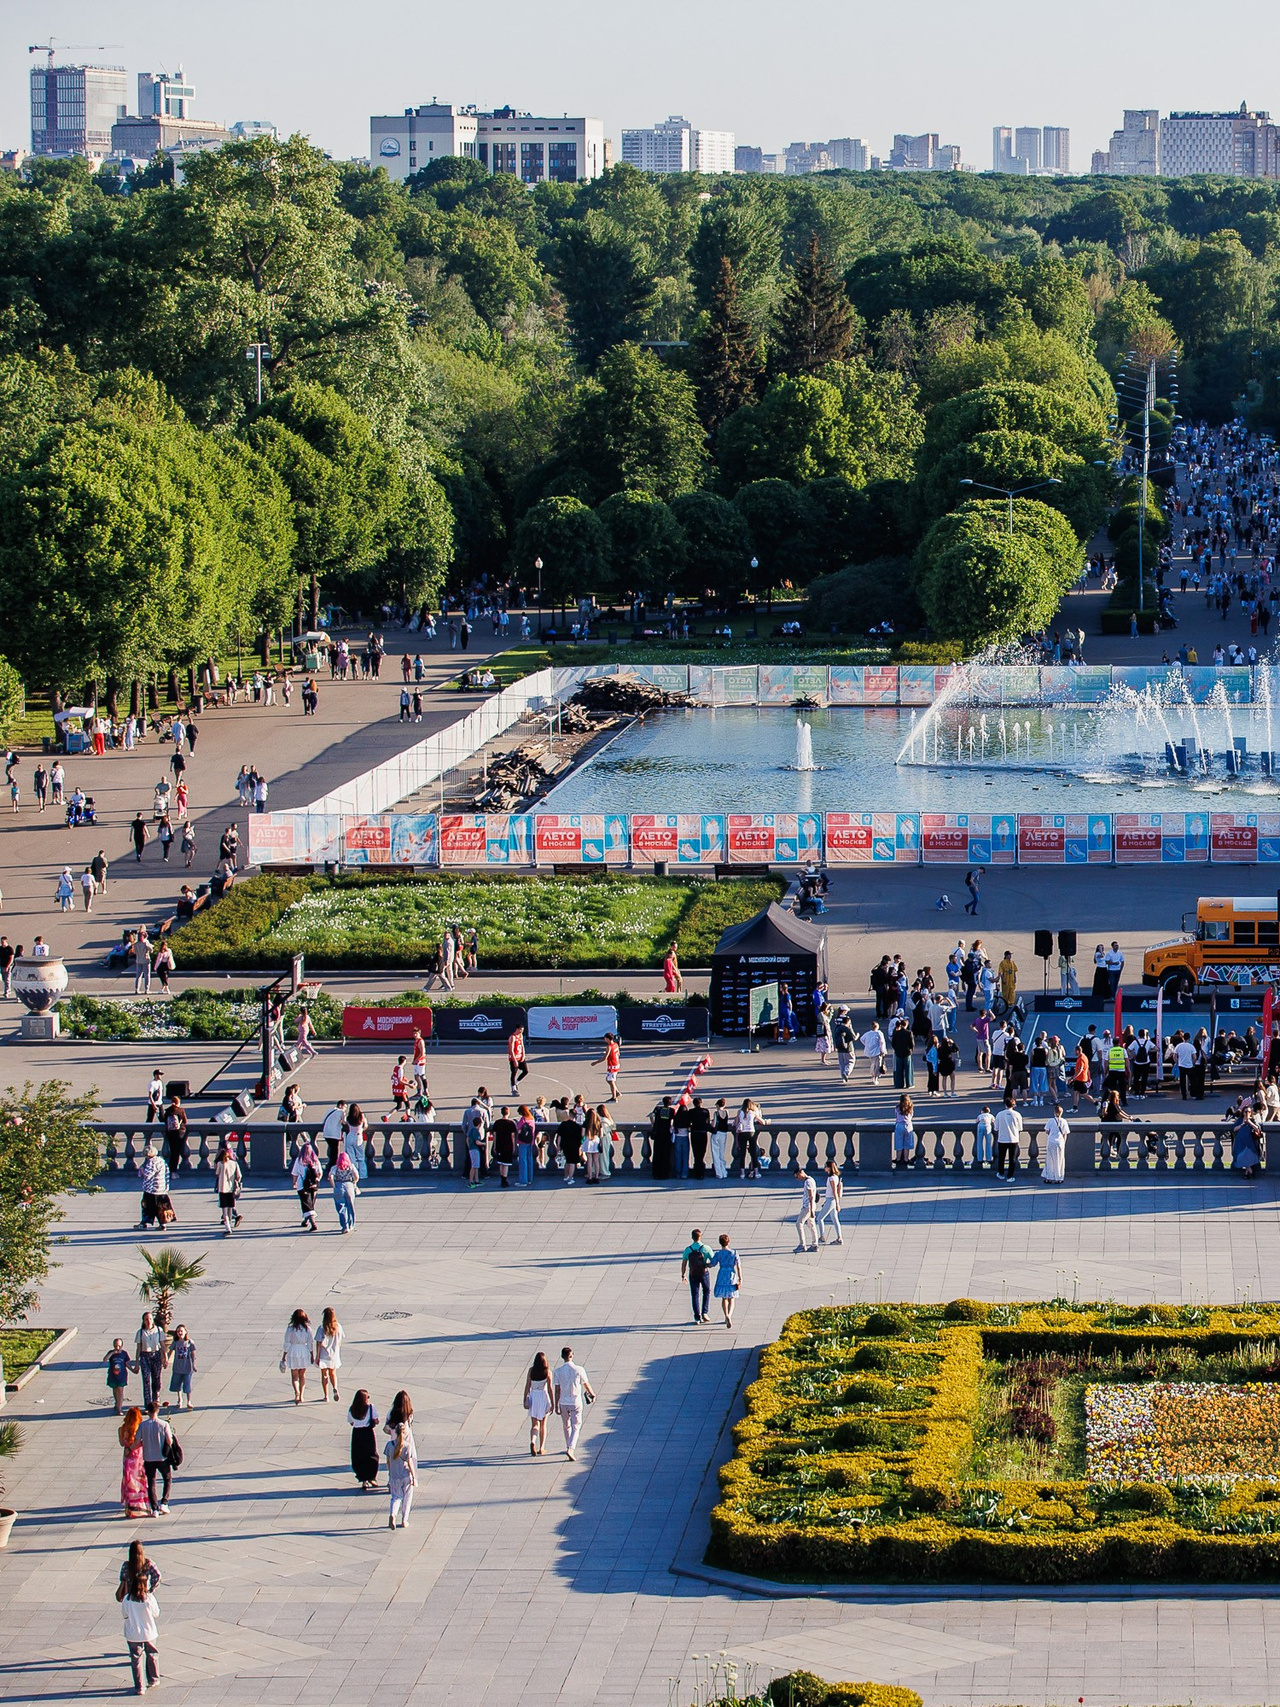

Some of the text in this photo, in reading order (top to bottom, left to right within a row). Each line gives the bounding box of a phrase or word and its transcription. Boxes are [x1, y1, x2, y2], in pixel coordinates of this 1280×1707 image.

[351, 830, 384, 840] ЛЕТО
[447, 831, 480, 841] ЛЕТО
[542, 831, 575, 840] ЛЕТО
[639, 831, 672, 841] ЛЕТО
[736, 831, 769, 840] ЛЕТО
[834, 830, 867, 839] ЛЕТО
[930, 830, 962, 840] ЛЕТО
[1026, 831, 1059, 841] ЛЕТО
[1122, 831, 1156, 840] ЛЕТО
[1218, 830, 1252, 840] ЛЕТО
[377, 1015, 413, 1024] МОСКОВСКИЙ
[562, 1014, 598, 1023] МОСКОВСКИЙ
